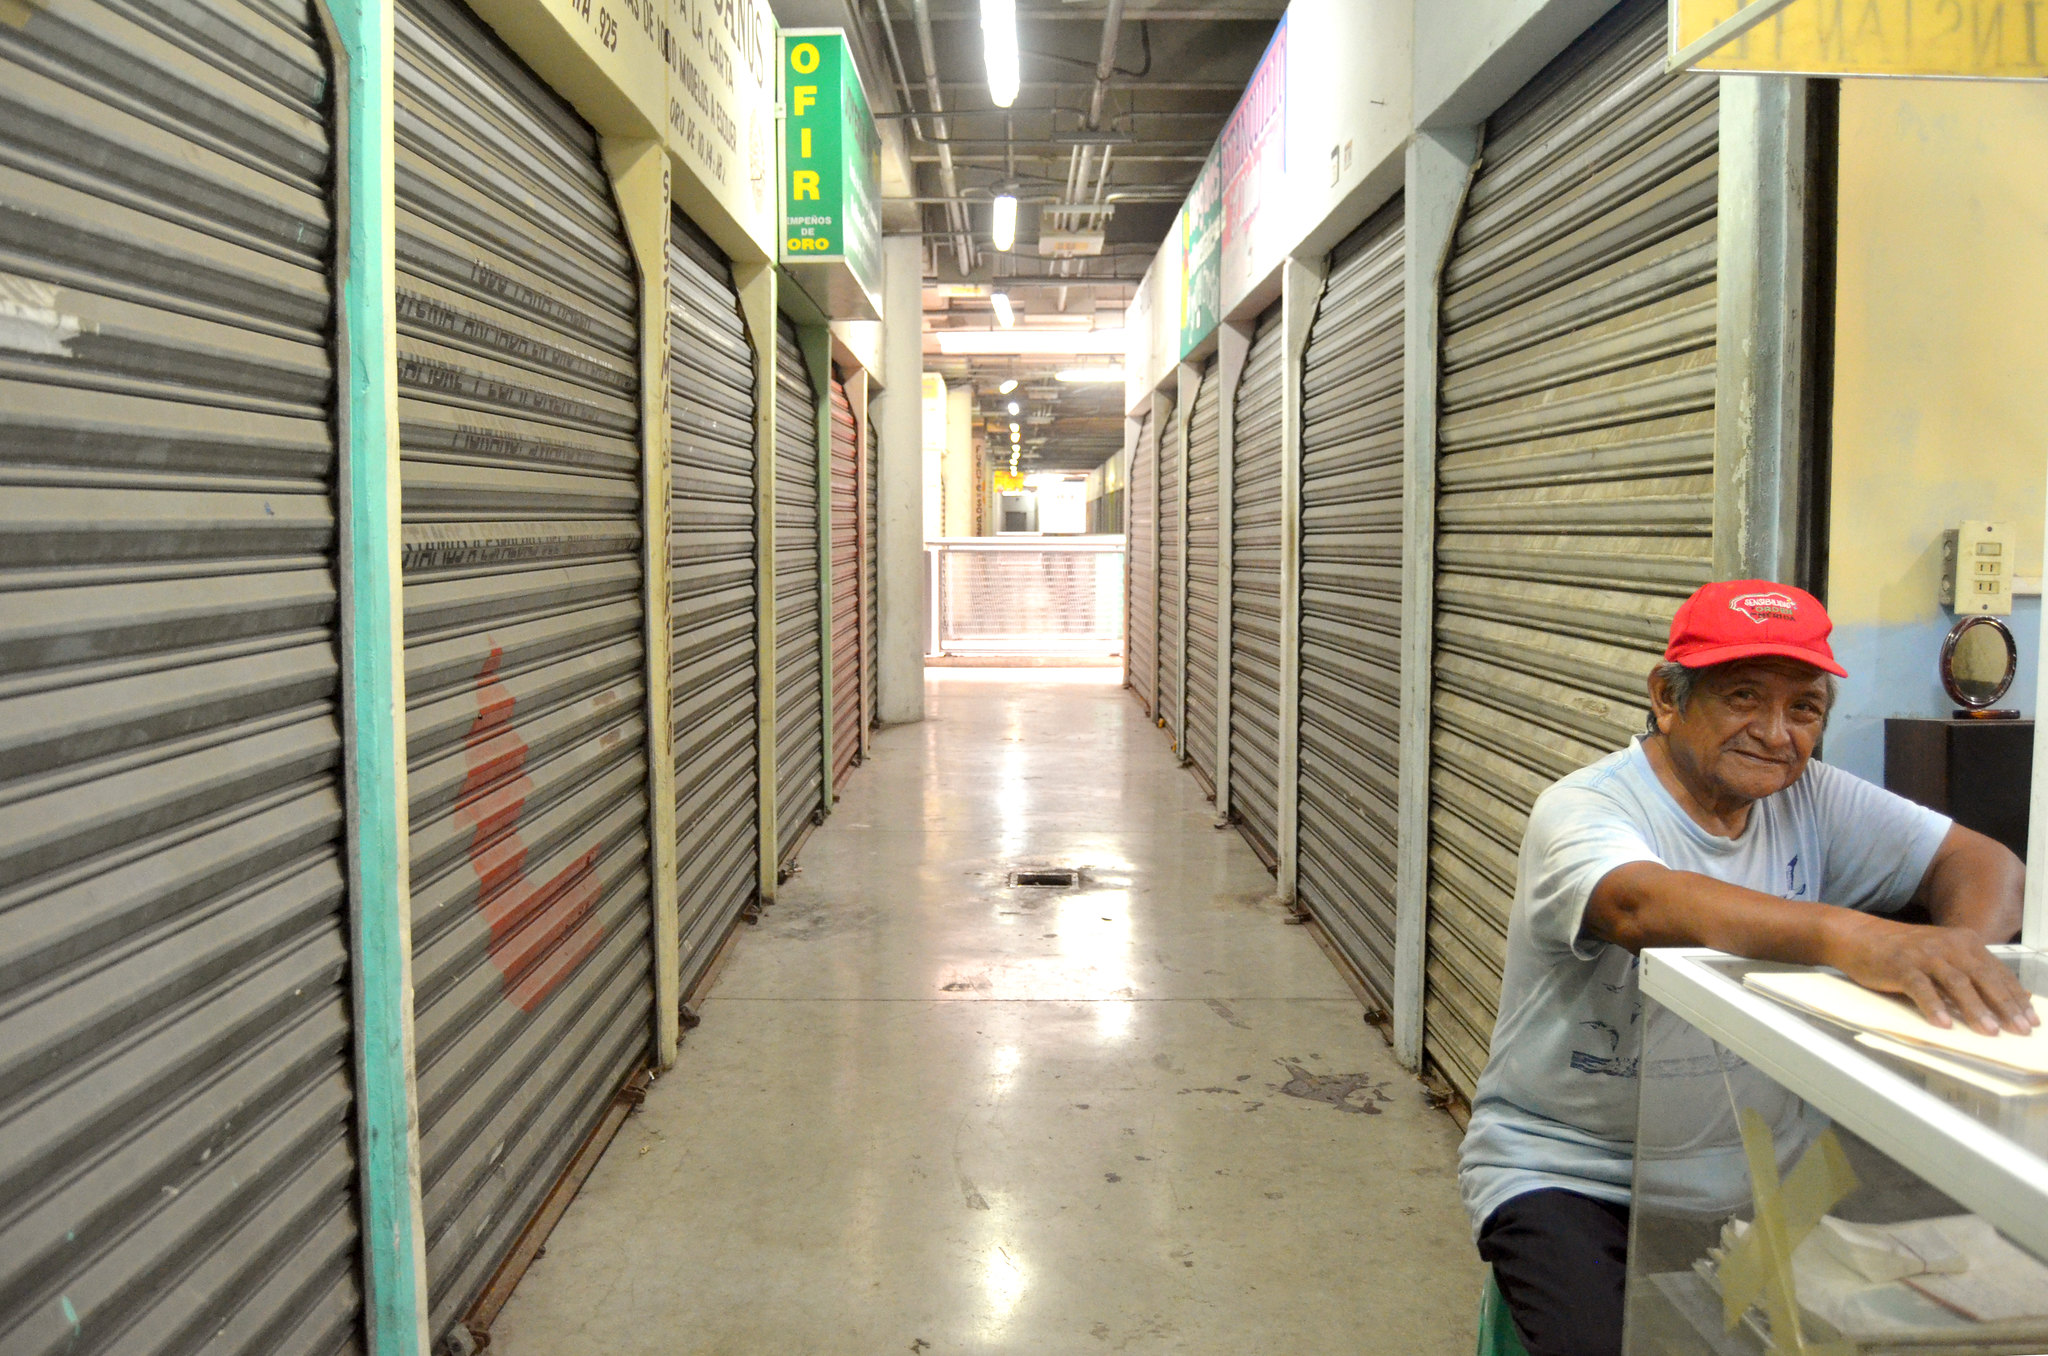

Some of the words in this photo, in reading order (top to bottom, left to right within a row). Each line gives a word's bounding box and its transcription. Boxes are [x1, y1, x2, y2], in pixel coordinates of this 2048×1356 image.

[643, 0, 654, 42] DE
[679, 47, 709, 116] MODELOS
[710, 92, 716, 126] A
[707, 27, 734, 93] CARTA
[714, 0, 764, 88] ANOS
[669, 96, 685, 137] ORO
[686, 116, 696, 150] DE
[790, 42, 821, 201] OFIR
[787, 237, 830, 251] ORO
[801, 227, 815, 236] DE
[660, 169, 671, 415] SISTEMA
[1755, 606, 1793, 615] ORDEN
